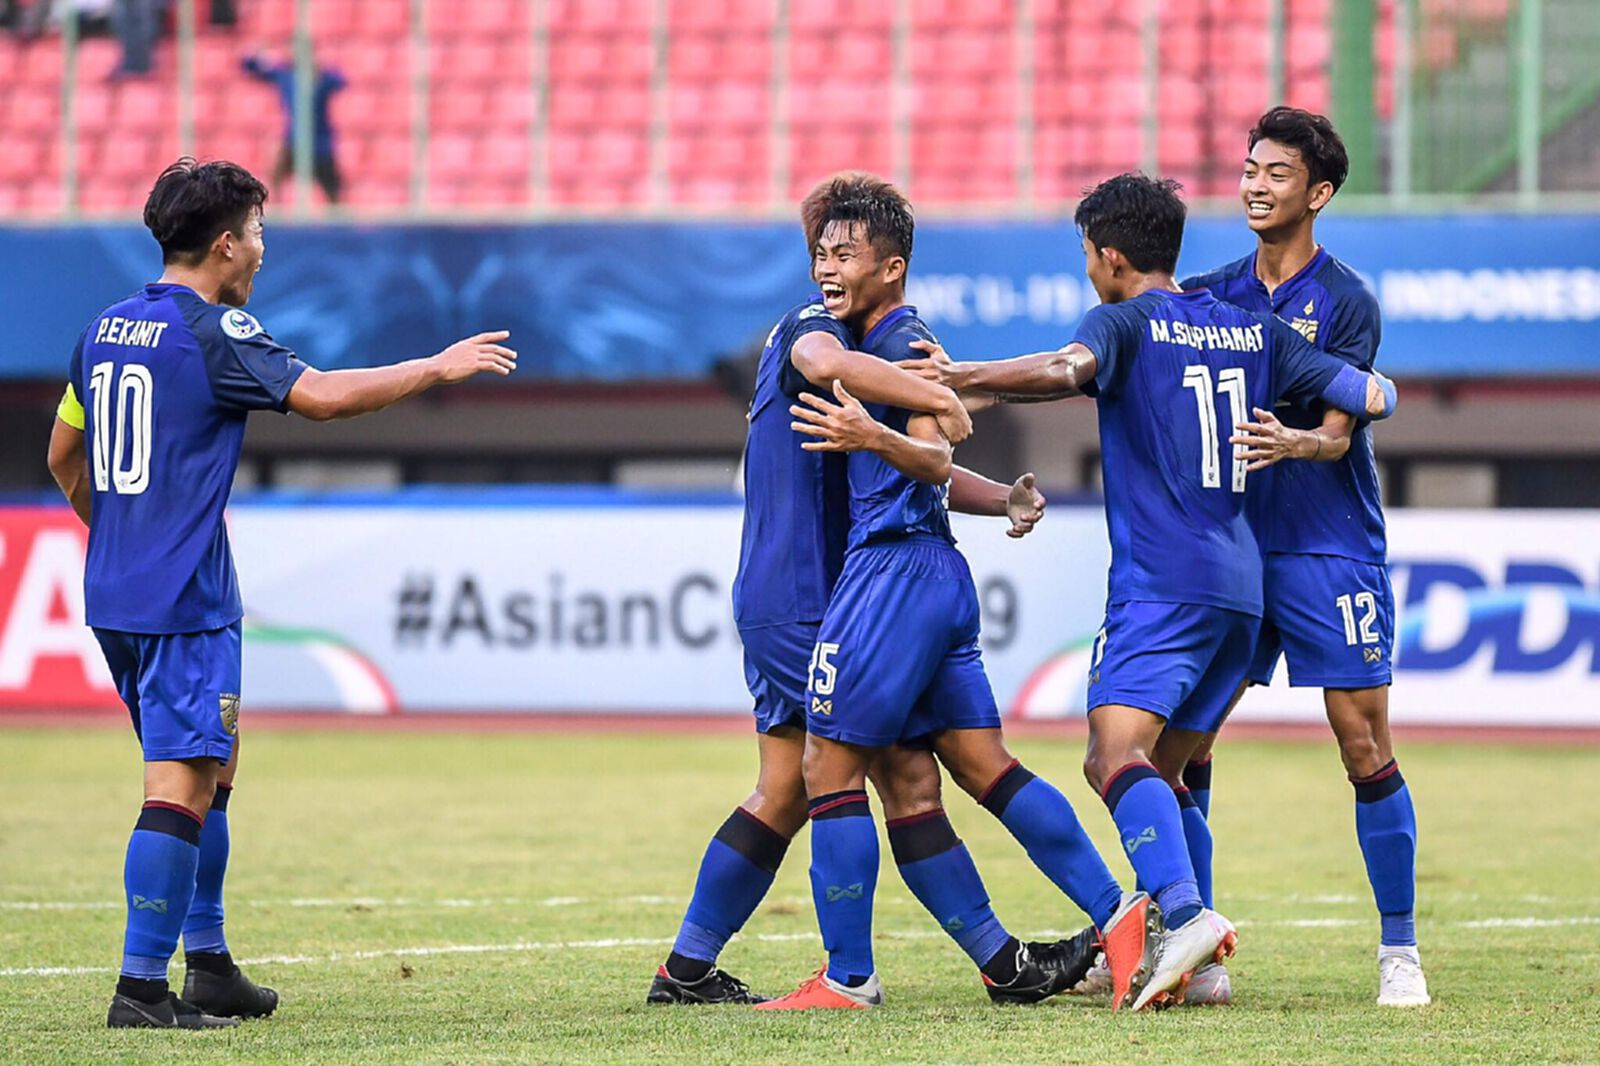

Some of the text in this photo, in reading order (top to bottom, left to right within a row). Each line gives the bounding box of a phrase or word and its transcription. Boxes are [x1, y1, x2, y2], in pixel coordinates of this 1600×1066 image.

[95, 316, 168, 348] P.EKANIT
[1150, 319, 1263, 352] M.SUPHANAT
[89, 361, 153, 495] 10
[1182, 364, 1250, 493] 11
[0, 528, 117, 690] A
[393, 571, 738, 652] #AsianC
[1336, 591, 1379, 646] 12
[1387, 560, 1600, 674] DD
